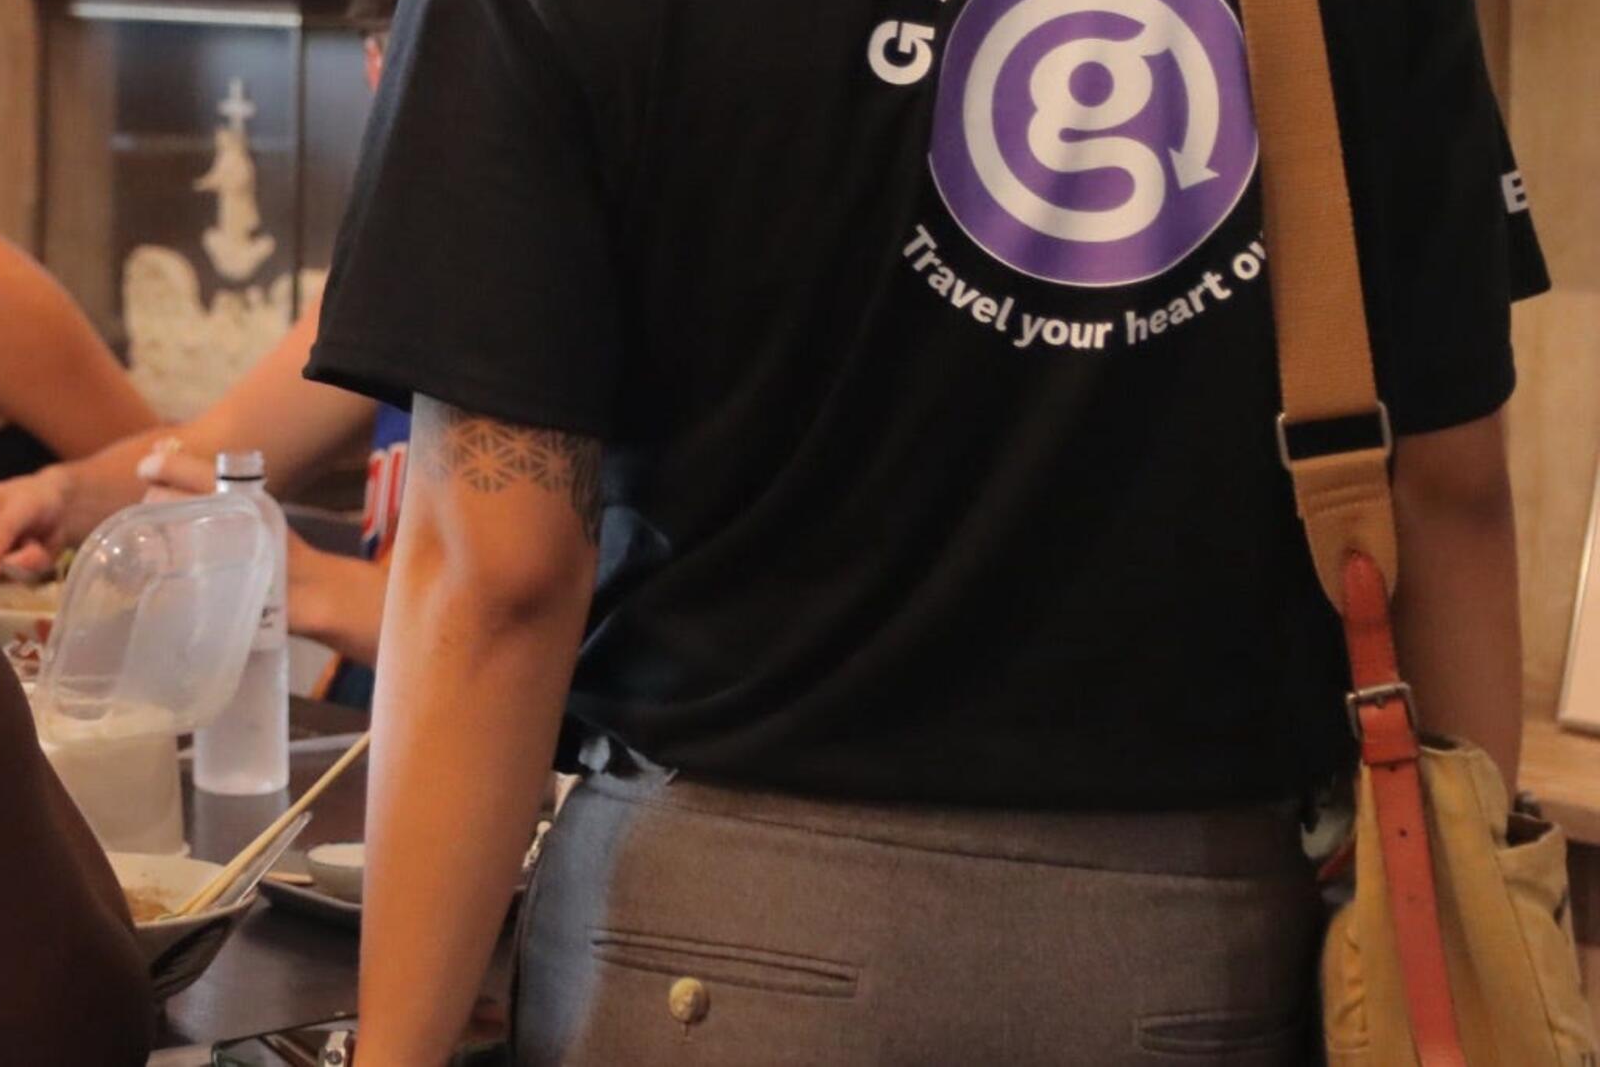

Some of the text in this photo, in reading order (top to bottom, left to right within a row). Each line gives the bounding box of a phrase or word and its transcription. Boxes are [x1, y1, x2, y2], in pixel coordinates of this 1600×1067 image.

[867, 19, 936, 86] G
[902, 223, 1015, 332] Travel
[1013, 313, 1113, 349] your
[1125, 271, 1232, 345] heart
